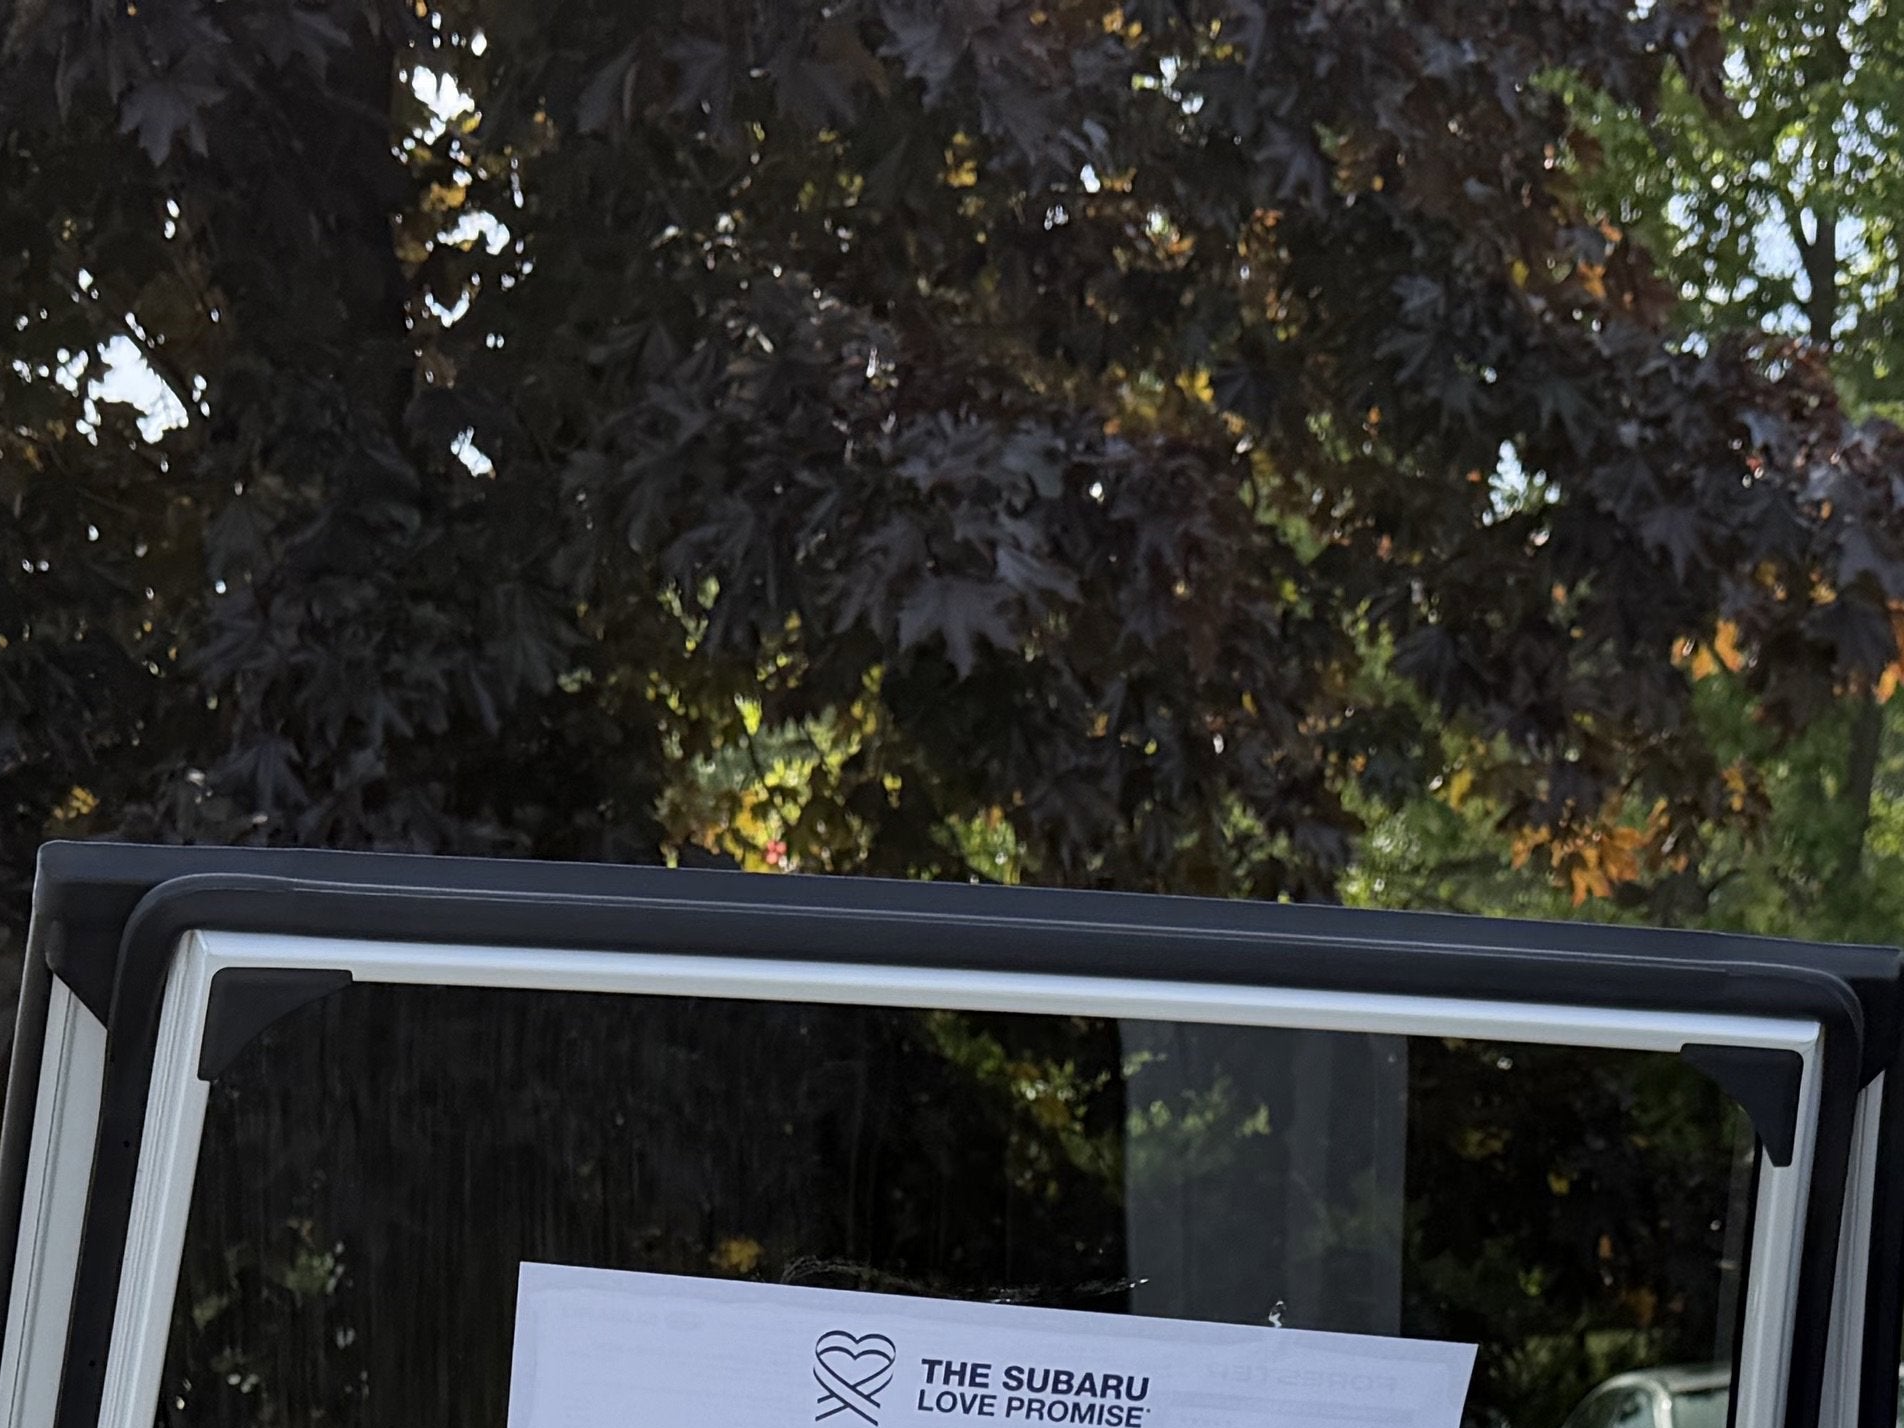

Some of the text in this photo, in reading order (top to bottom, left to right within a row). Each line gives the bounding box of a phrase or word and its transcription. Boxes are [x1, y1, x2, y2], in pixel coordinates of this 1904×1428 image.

[921, 1358, 1149, 1401] THE SUBARU
[918, 1389, 997, 1416] LOVE
